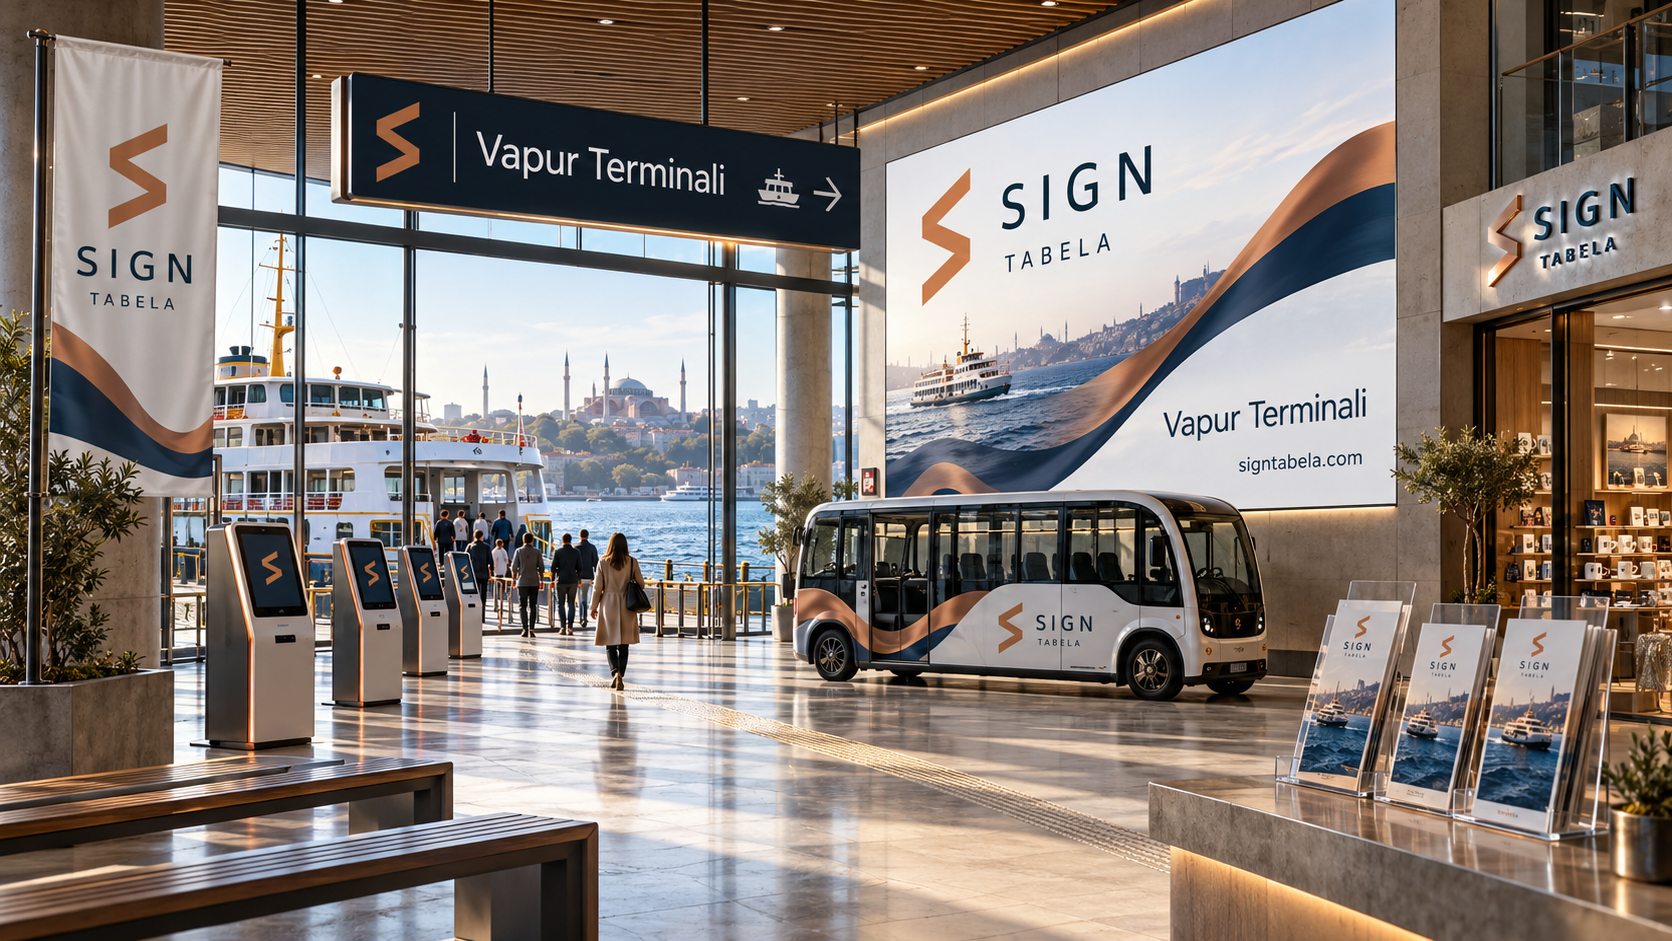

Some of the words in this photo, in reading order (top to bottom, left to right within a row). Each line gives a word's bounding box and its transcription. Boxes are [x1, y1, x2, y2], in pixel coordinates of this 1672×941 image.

[476, 130, 579, 180] Vapur
[588, 146, 725, 196] Terminali
[1001, 144, 1152, 230] SIGN
[1534, 177, 1634, 240] SIGN
[77, 246, 192, 284] SIGN
[1005, 233, 1111, 273] TABELA
[1540, 237, 1617, 269] TABELA
[90, 292, 175, 311] TABELA
[1164, 411, 1241, 442] Vapur
[1248, 388, 1367, 428] Terminali
[1238, 453, 1363, 475] signtabela.com
[1036, 614, 1092, 632] SIGN
[1037, 638, 1081, 647] TABELA
[1343, 641, 1372, 651] SIGN
[1429, 661, 1456, 671] SIGN
[1519, 660, 1549, 671] SIGN
